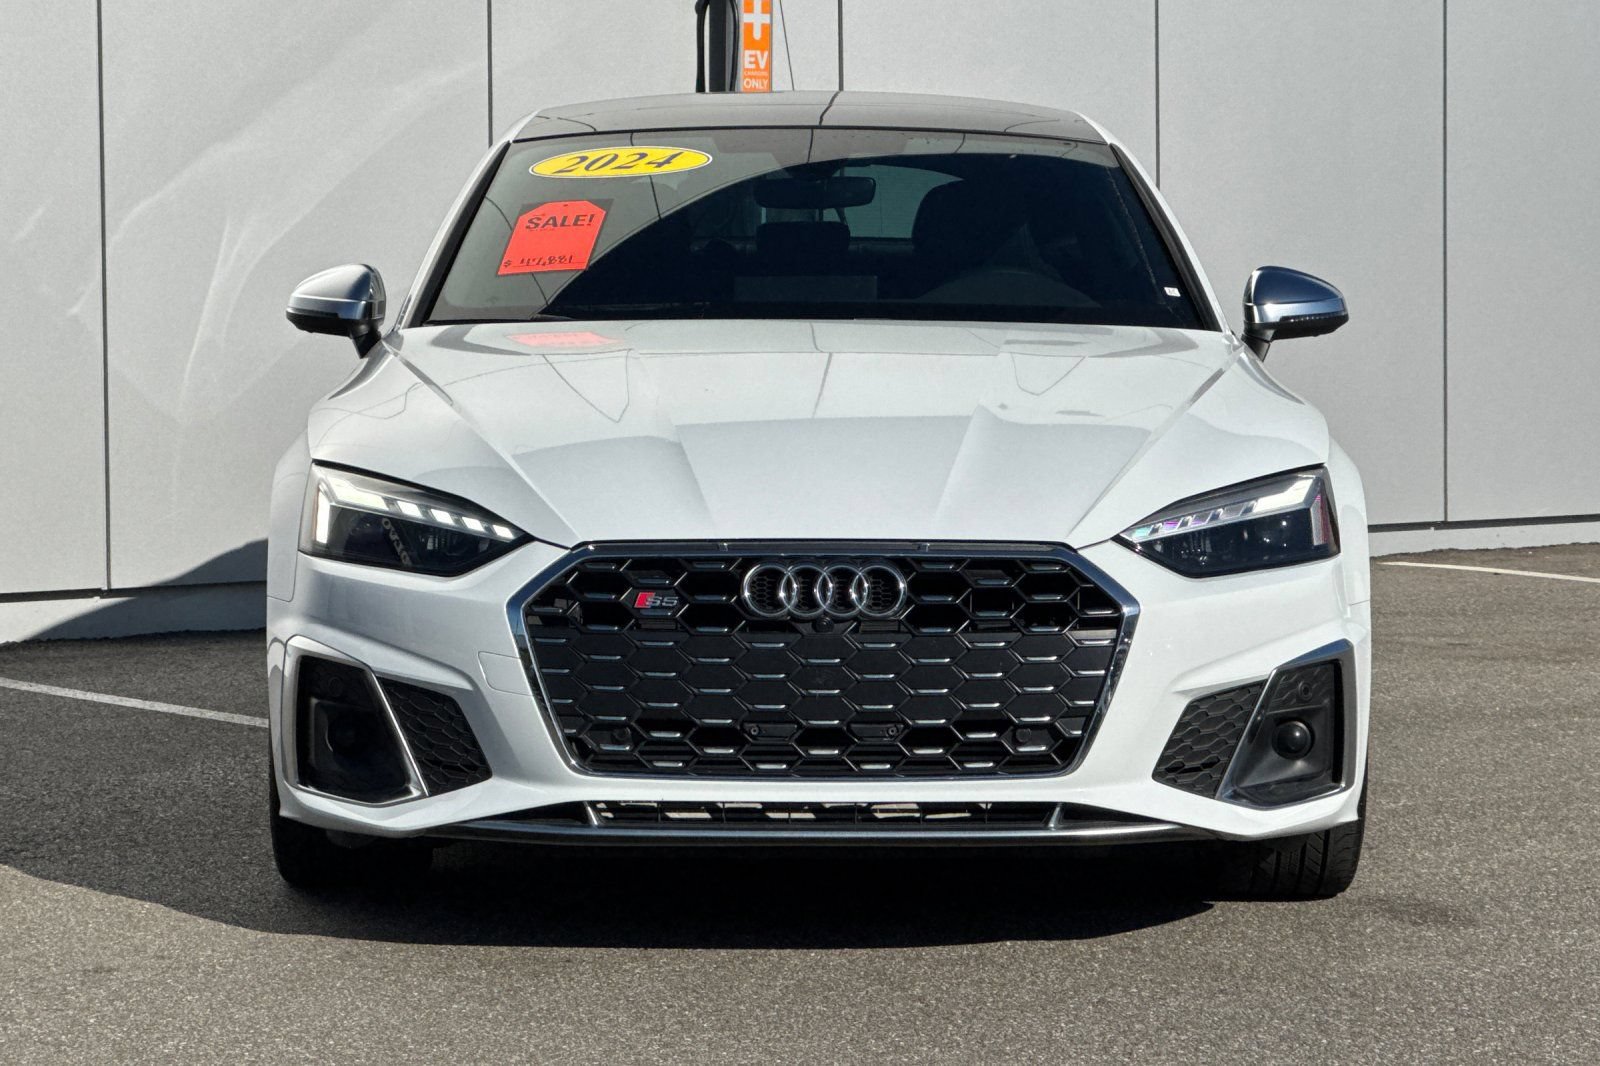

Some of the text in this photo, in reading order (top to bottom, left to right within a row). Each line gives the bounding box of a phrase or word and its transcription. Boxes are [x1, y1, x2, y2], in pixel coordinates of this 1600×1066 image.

[744, 50, 769, 69] EV
[743, 78, 769, 89] ONLY
[551, 151, 685, 174] 2024
[525, 214, 595, 229] SALE!
